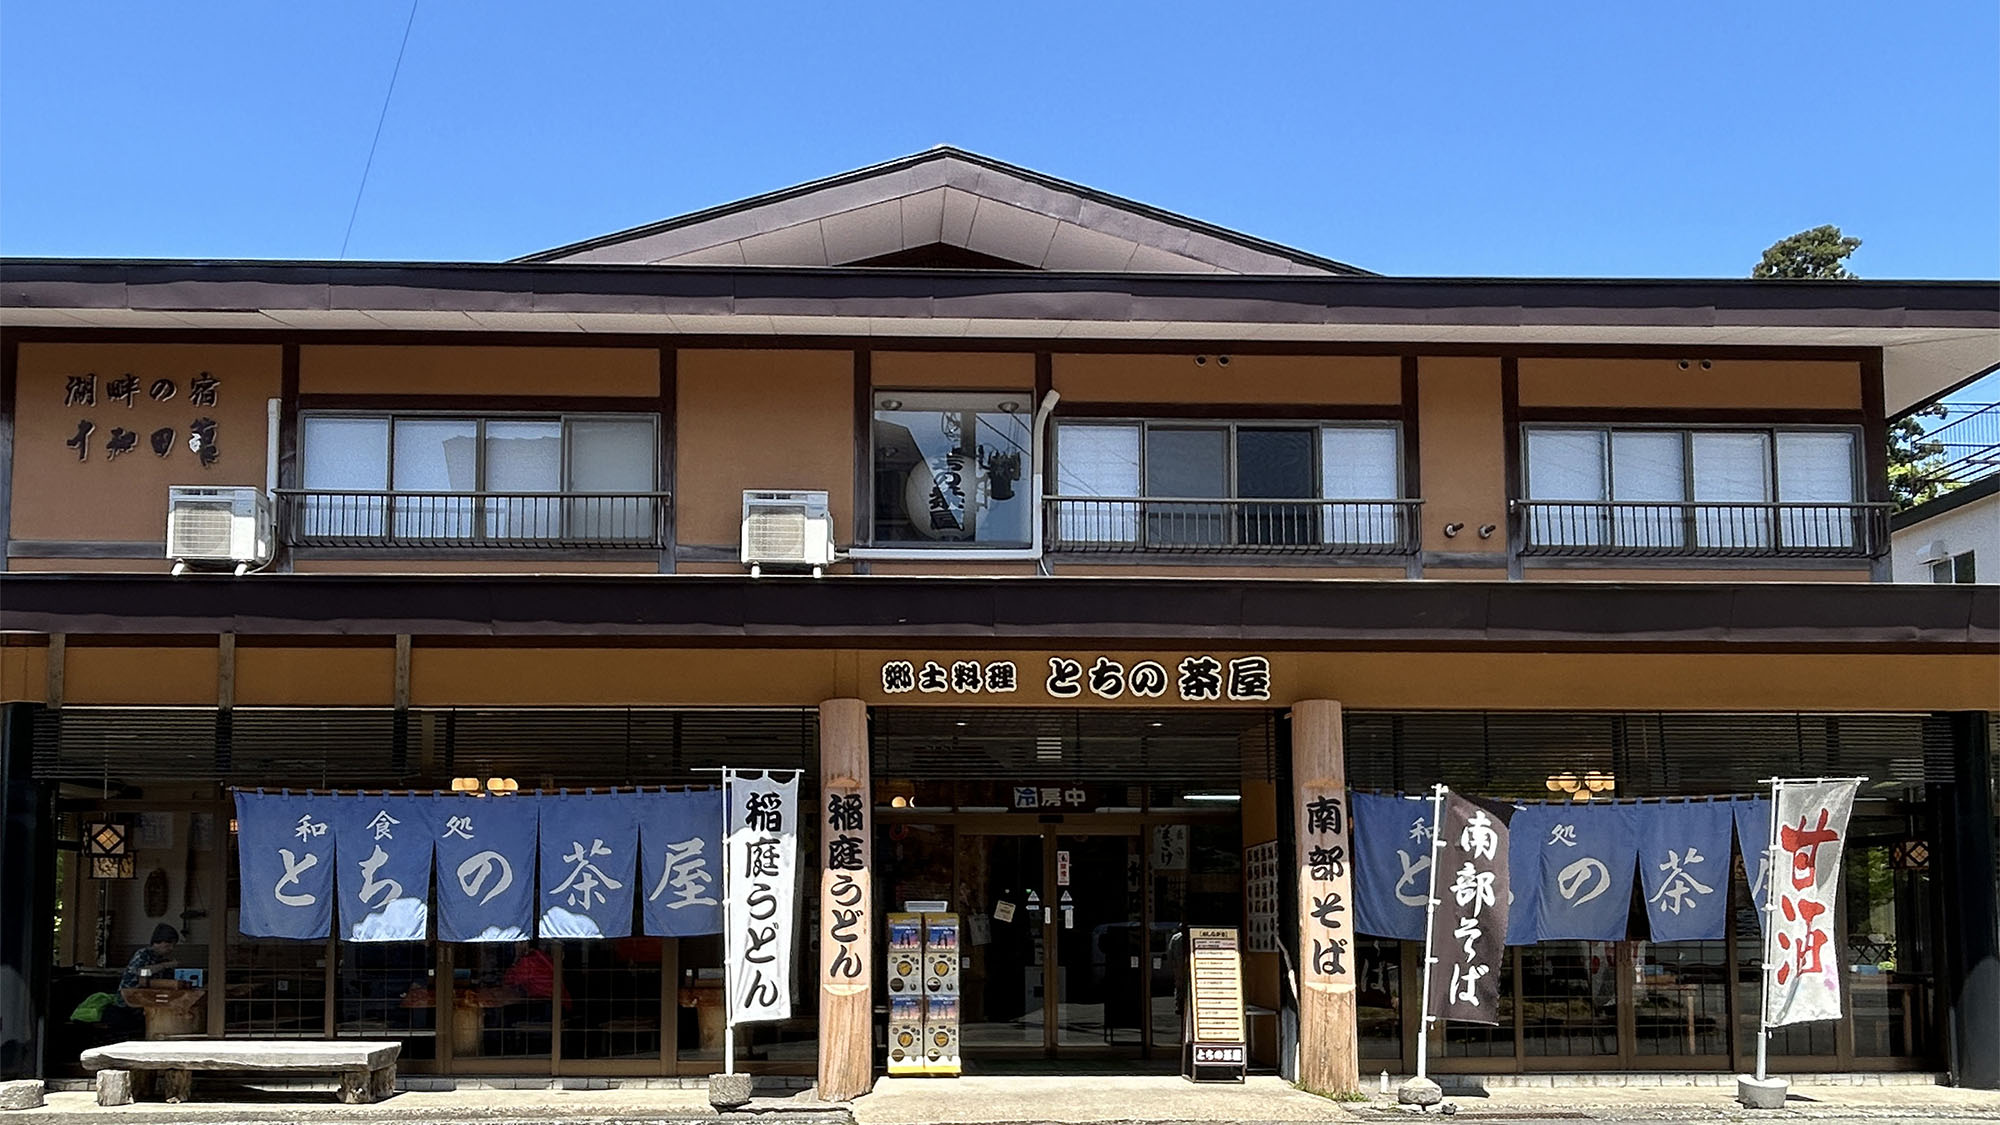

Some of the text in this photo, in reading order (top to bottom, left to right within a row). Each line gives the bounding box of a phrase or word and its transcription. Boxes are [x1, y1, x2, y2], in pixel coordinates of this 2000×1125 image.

[65, 371, 221, 408] 湖畔の宿
[881, 656, 1271, 700] 郷土料理 とちの茶屋
[1014, 787, 1086, 807] 冷房中
[295, 810, 474, 843] 和食処
[275, 838, 718, 911] とちの茶屋
[744, 792, 782, 1009] 稲庭うどん
[828, 793, 865, 978] 稲庭うどん
[1777, 808, 1840, 985] 甘酒
[1450, 810, 1498, 1007] 南部そば
[1197, 1049, 1241, 1061] とちの茶屋
